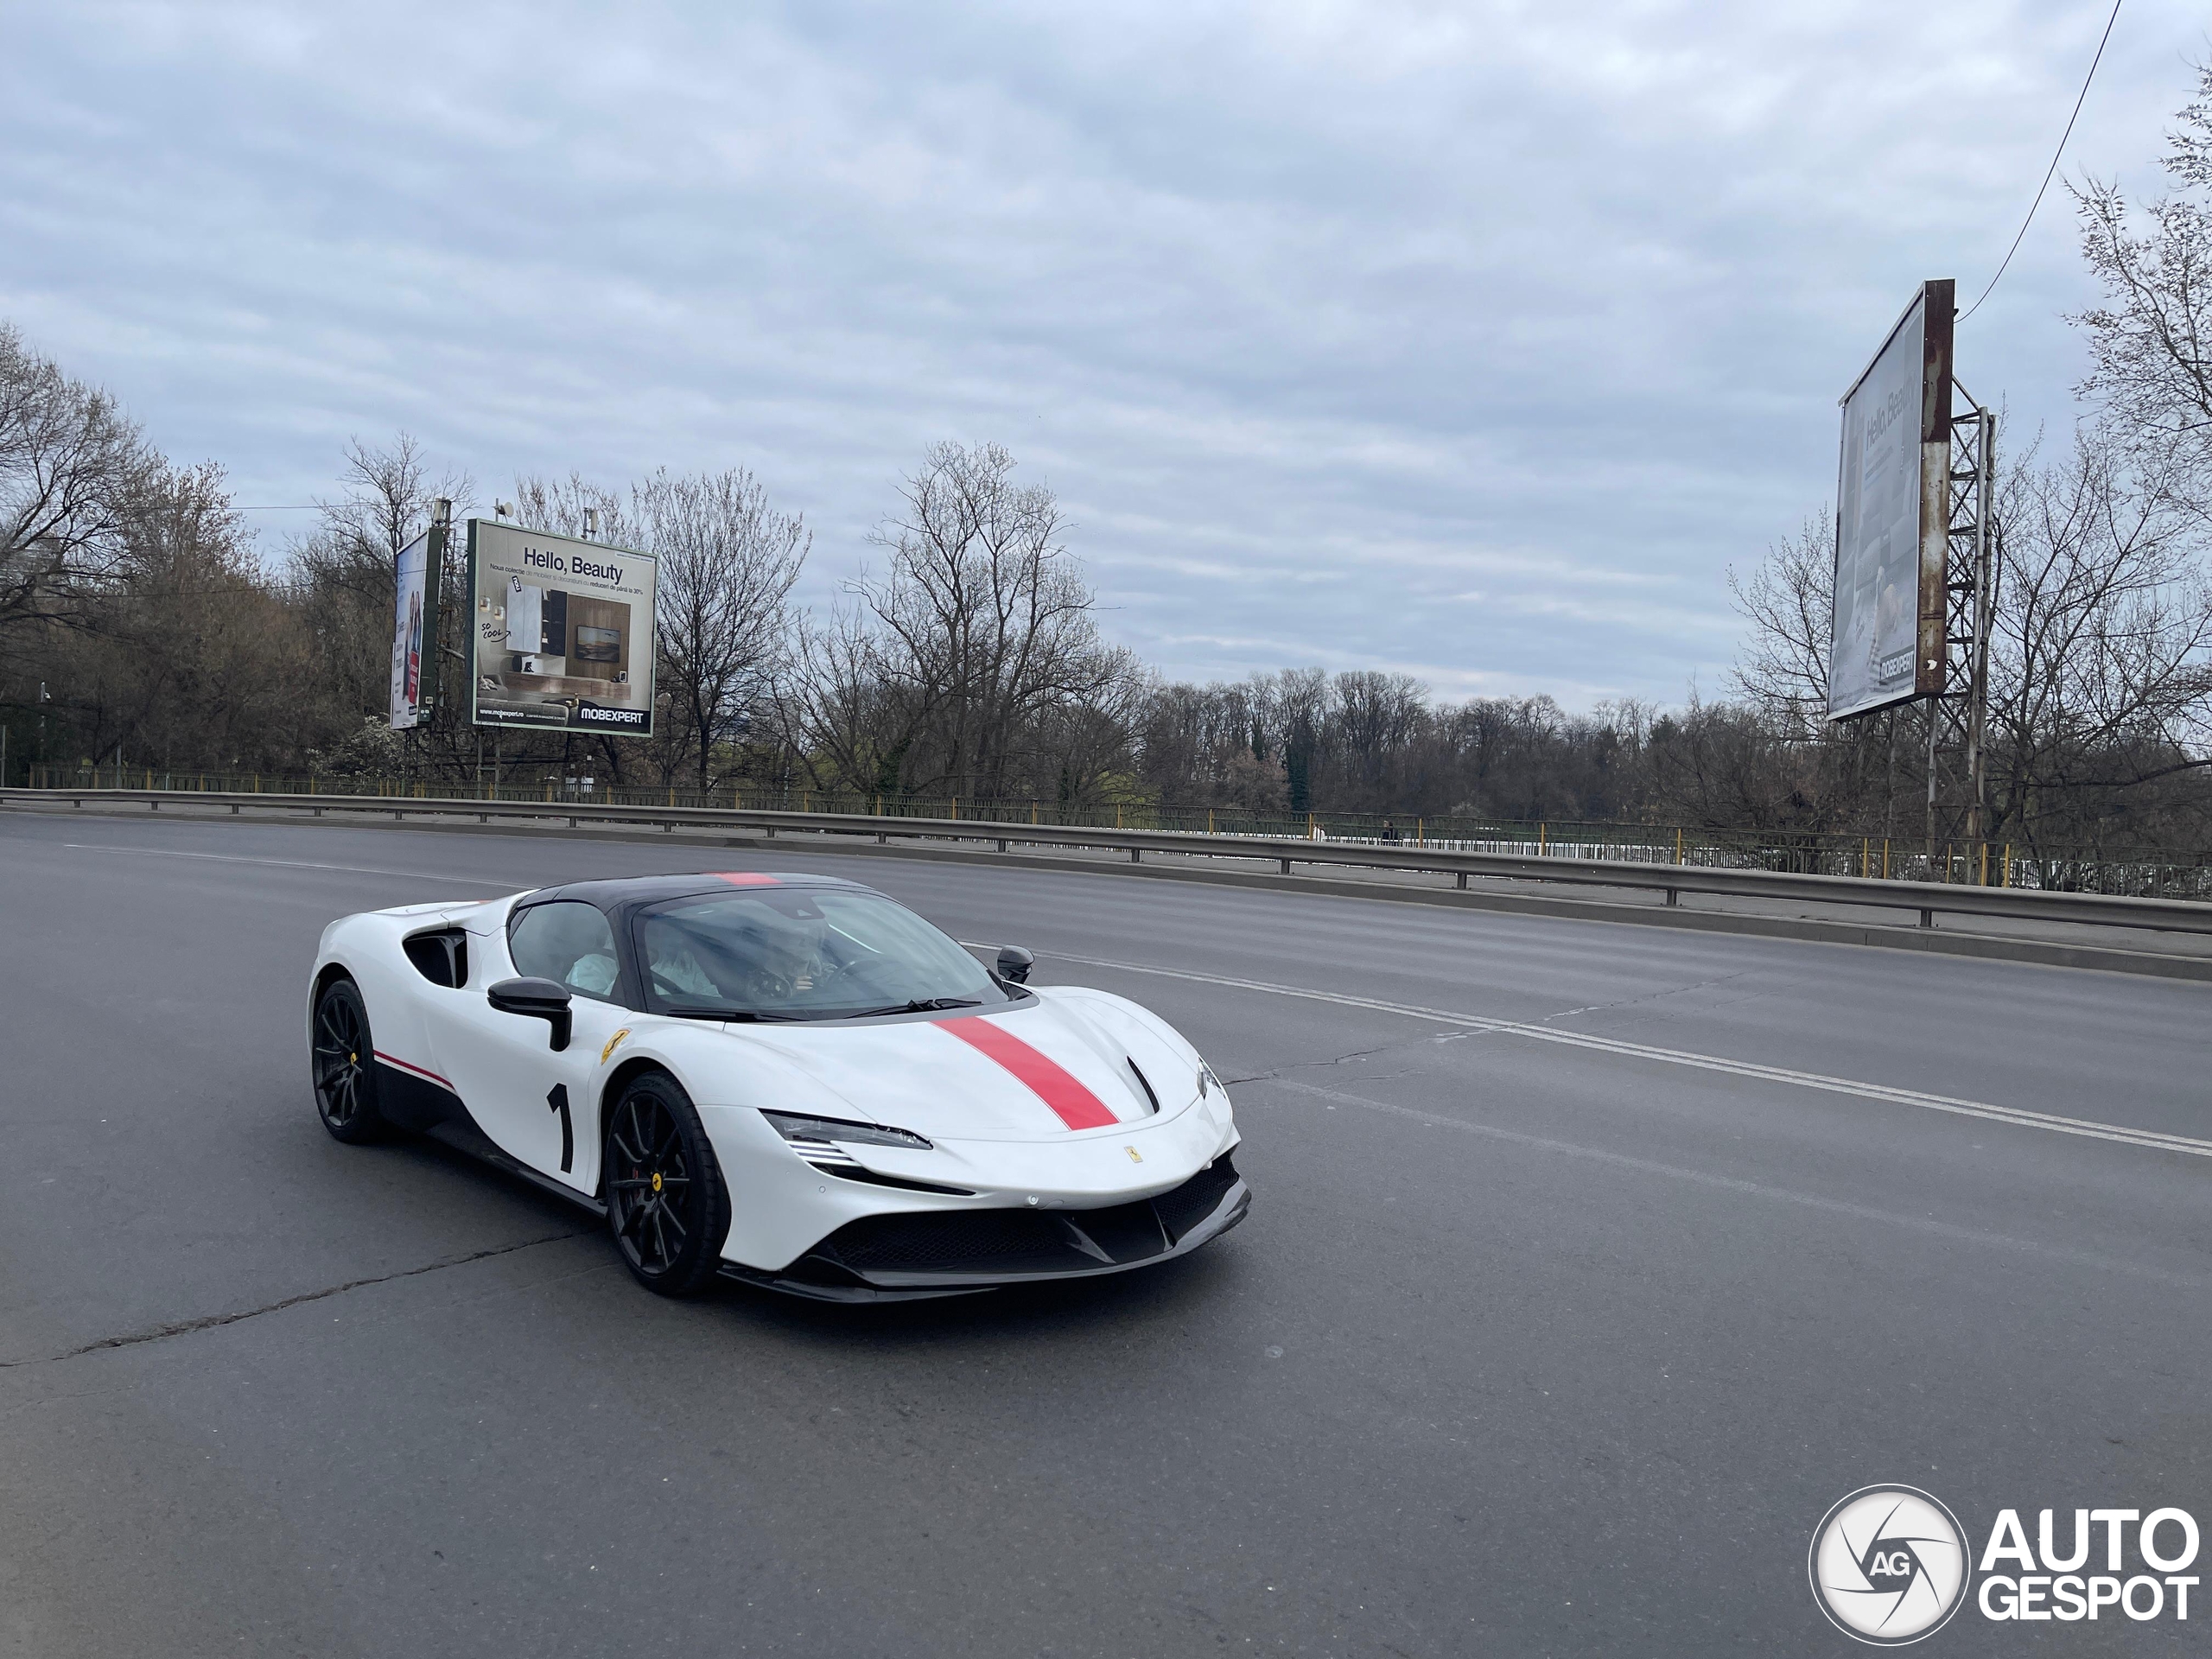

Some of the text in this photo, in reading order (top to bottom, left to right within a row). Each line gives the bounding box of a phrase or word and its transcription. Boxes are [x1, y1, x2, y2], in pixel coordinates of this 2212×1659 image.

[1866, 406, 1887, 451] Hello,
[524, 547, 623, 585] Hello, Beauty
[483, 629, 503, 639] COOL
[480, 709, 524, 719] www.mobexpert.ro
[581, 708, 644, 723] MOBEXPERT
[546, 1083, 574, 1174] 1
